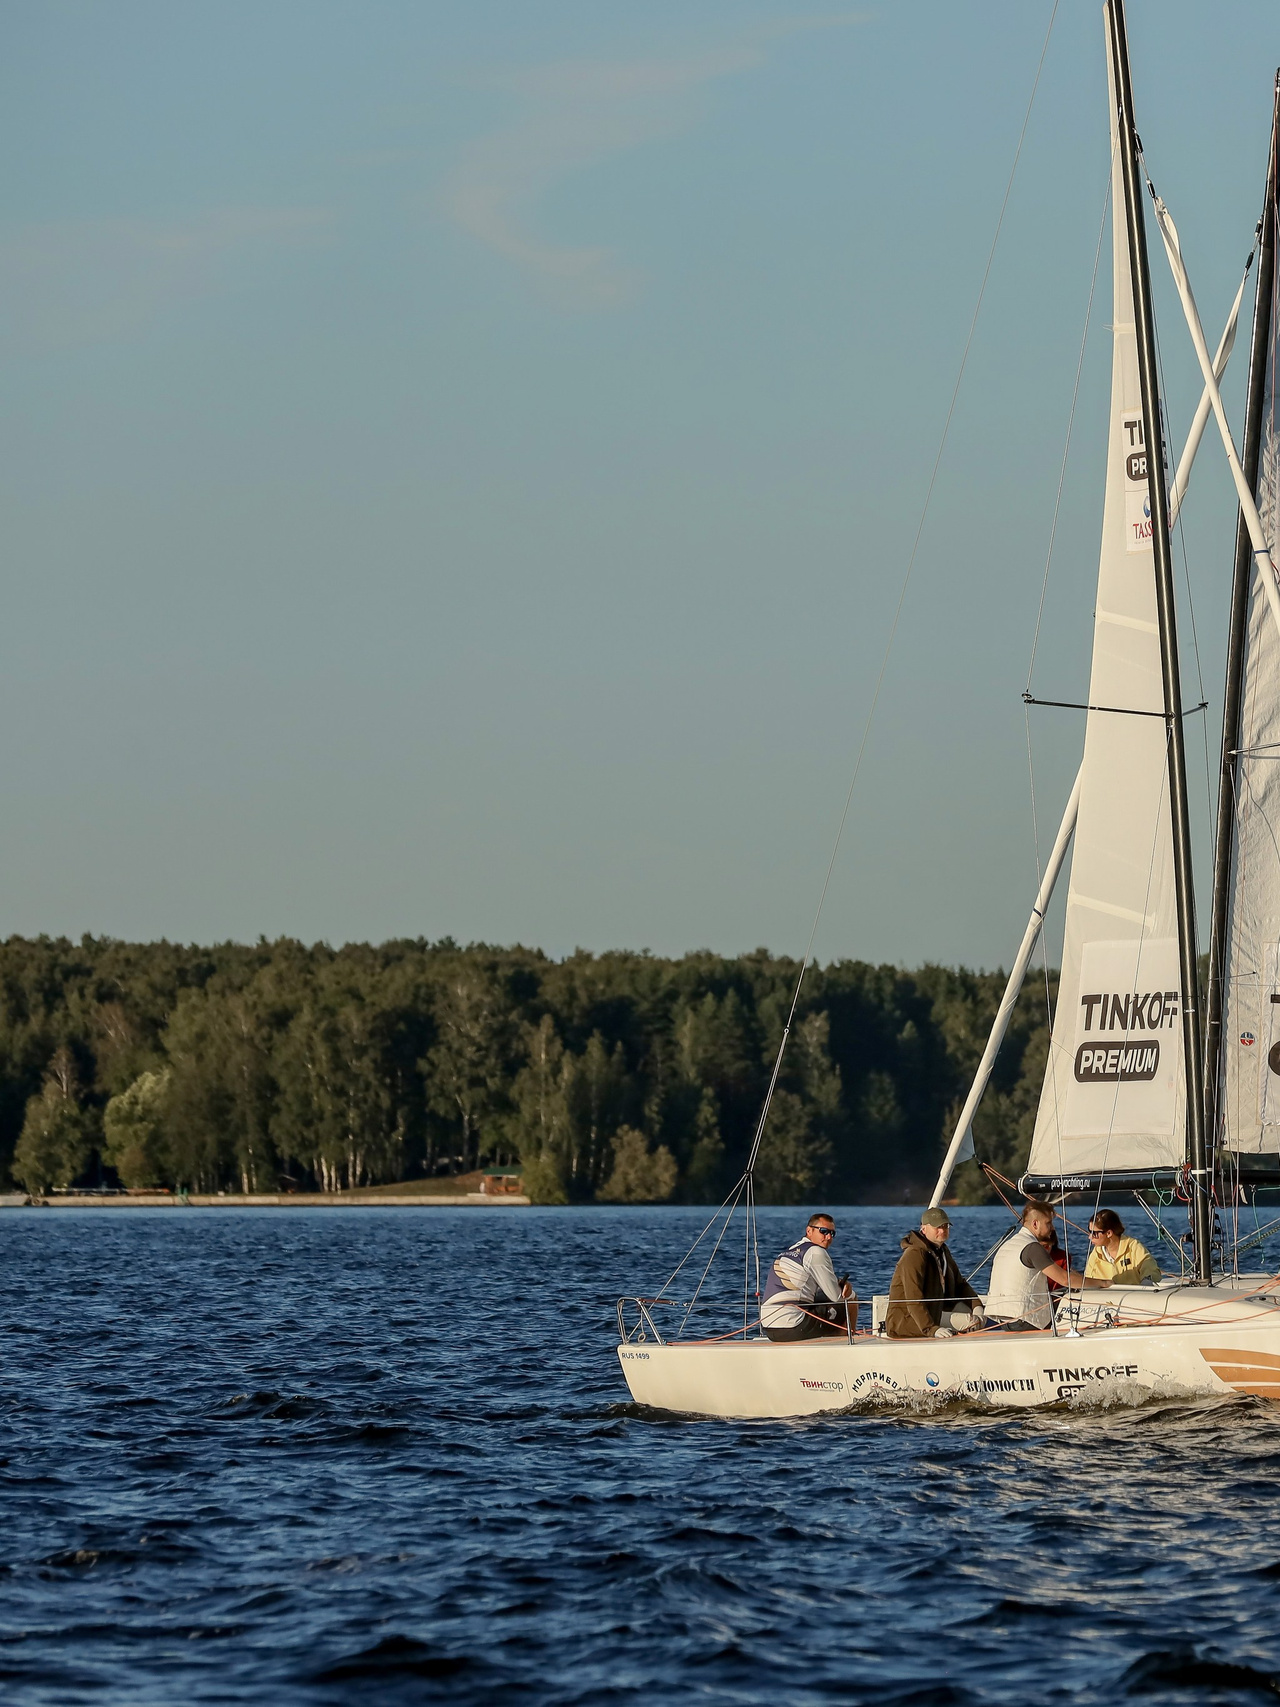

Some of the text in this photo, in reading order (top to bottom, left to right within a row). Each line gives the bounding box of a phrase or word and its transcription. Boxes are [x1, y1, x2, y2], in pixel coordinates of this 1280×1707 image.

[1081, 991, 1178, 1031] TINKOFF
[1080, 1048, 1157, 1075] PREMIUM
[621, 1352, 635, 1360] RUS
[852, 1371, 899, 1393] МОРПРИБО
[1043, 1364, 1139, 1383] TINKOFF
